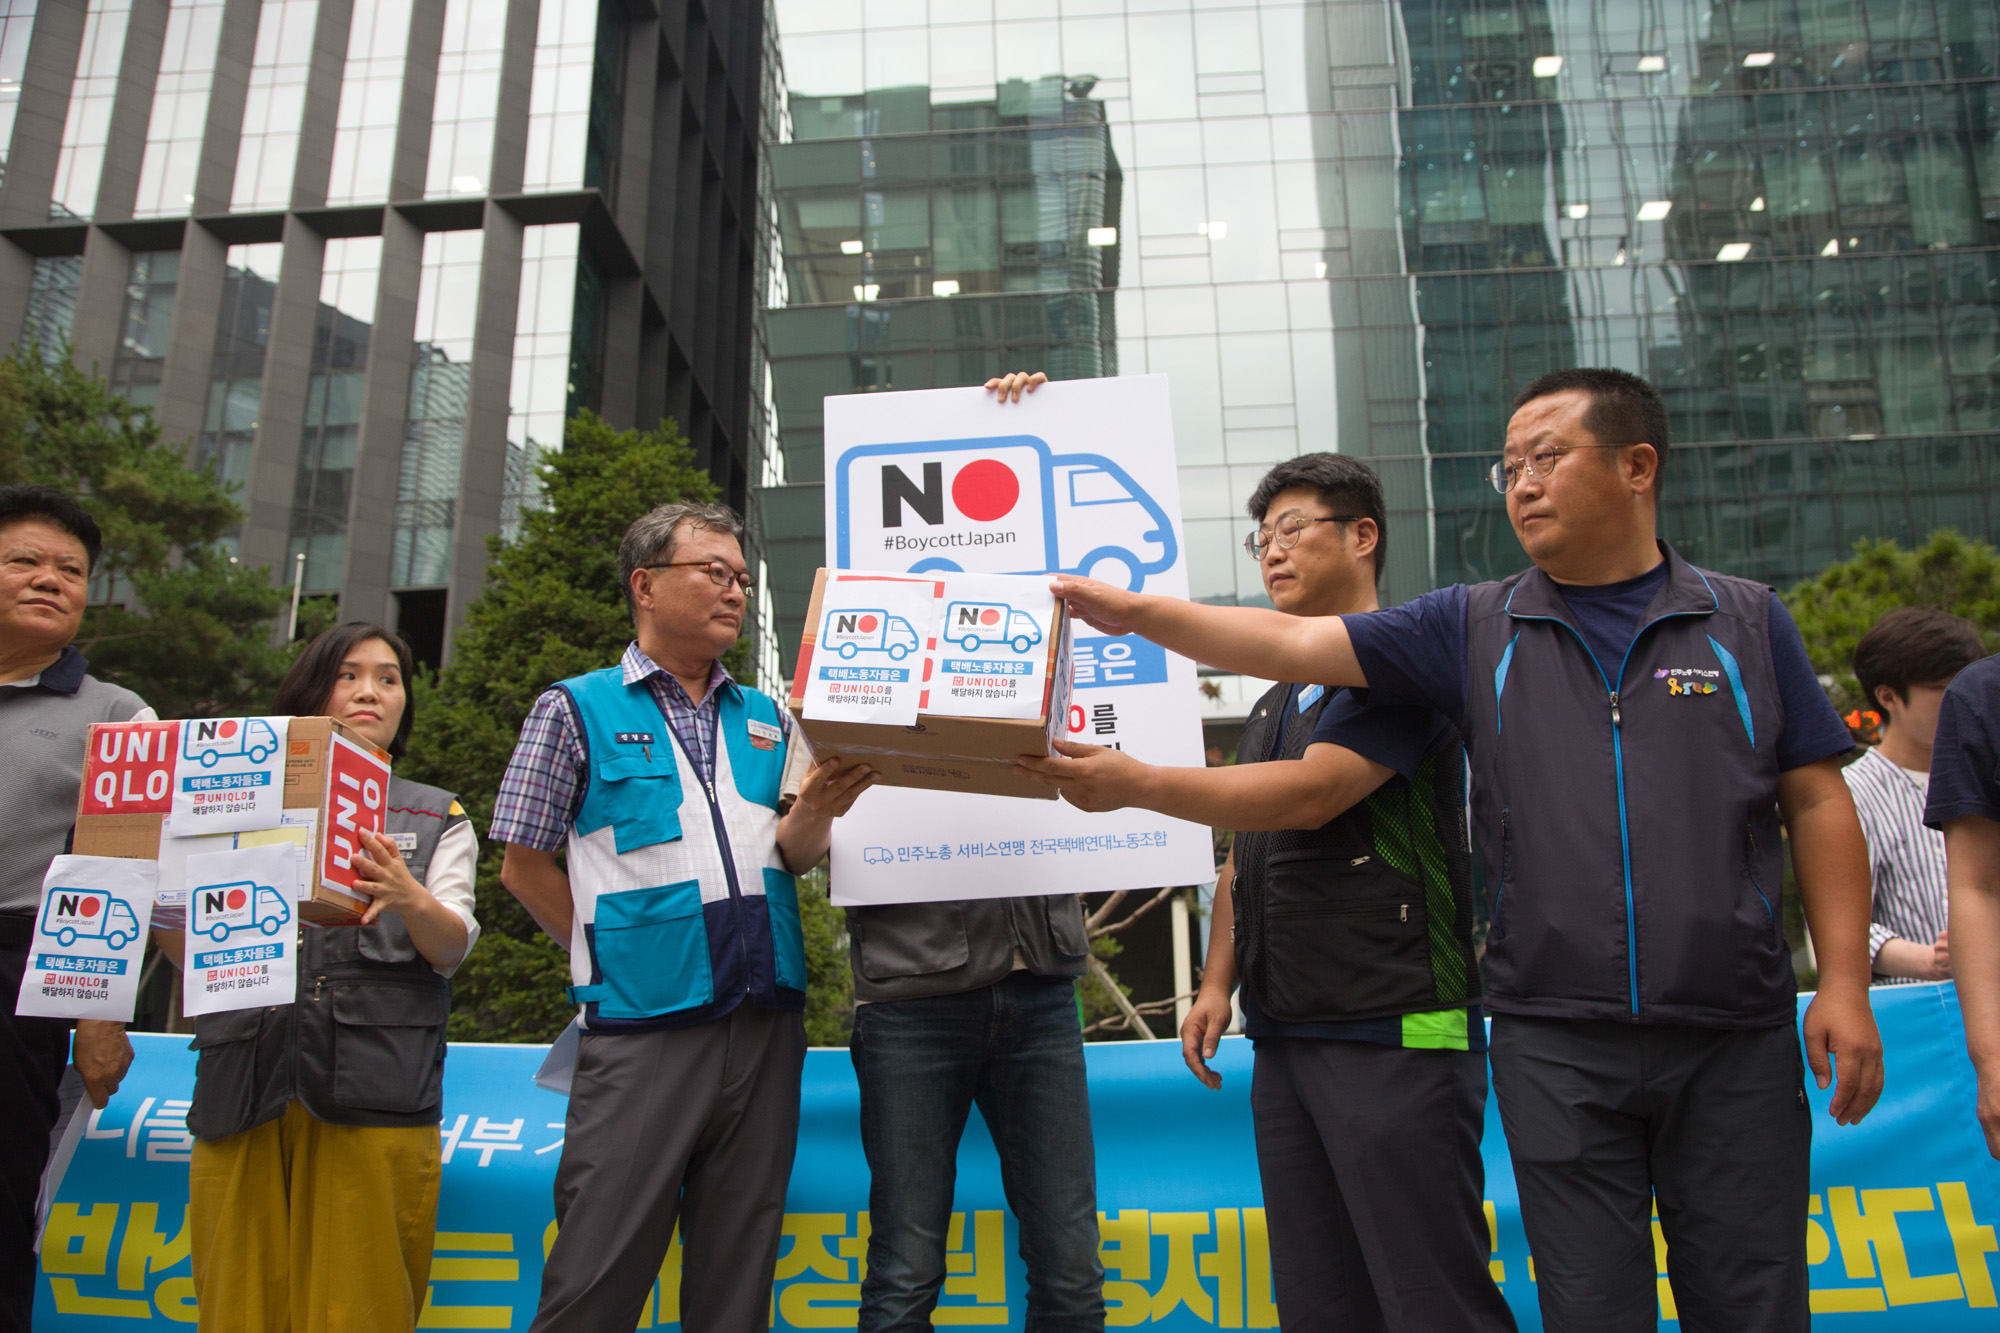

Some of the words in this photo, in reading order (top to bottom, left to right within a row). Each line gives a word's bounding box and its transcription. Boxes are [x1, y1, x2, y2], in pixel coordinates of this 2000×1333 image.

[884, 530, 1017, 551] #BoycottJapan
[828, 668, 901, 681] 택배노동자들은
[950, 661, 1025, 674] 택배노동자들은
[827, 694, 859, 705] 배달하지
[861, 695, 892, 705] 않습니다
[951, 688, 983, 698] 배달하지
[985, 688, 1017, 699] 않습니다
[100, 731, 168, 763] UNI
[94, 769, 169, 808] QLO
[191, 773, 263, 790] 택배노동자들은
[192, 804, 223, 815] 배달하지
[226, 802, 256, 814] 않습니다
[333, 771, 360, 870] UNI
[897, 843, 952, 863] 민주노총
[956, 839, 1026, 859] 서비스연맹
[1029, 830, 1168, 855] 전국택배연대노동조합
[45, 956, 118, 973] 택배노동자들은
[203, 946, 276, 966] 택배노동자들은
[42, 986, 74, 998] 배달하지
[76, 988, 109, 1000] 않습니다
[206, 980, 235, 993] 배달하지
[237, 976, 270, 988] 않습니다
